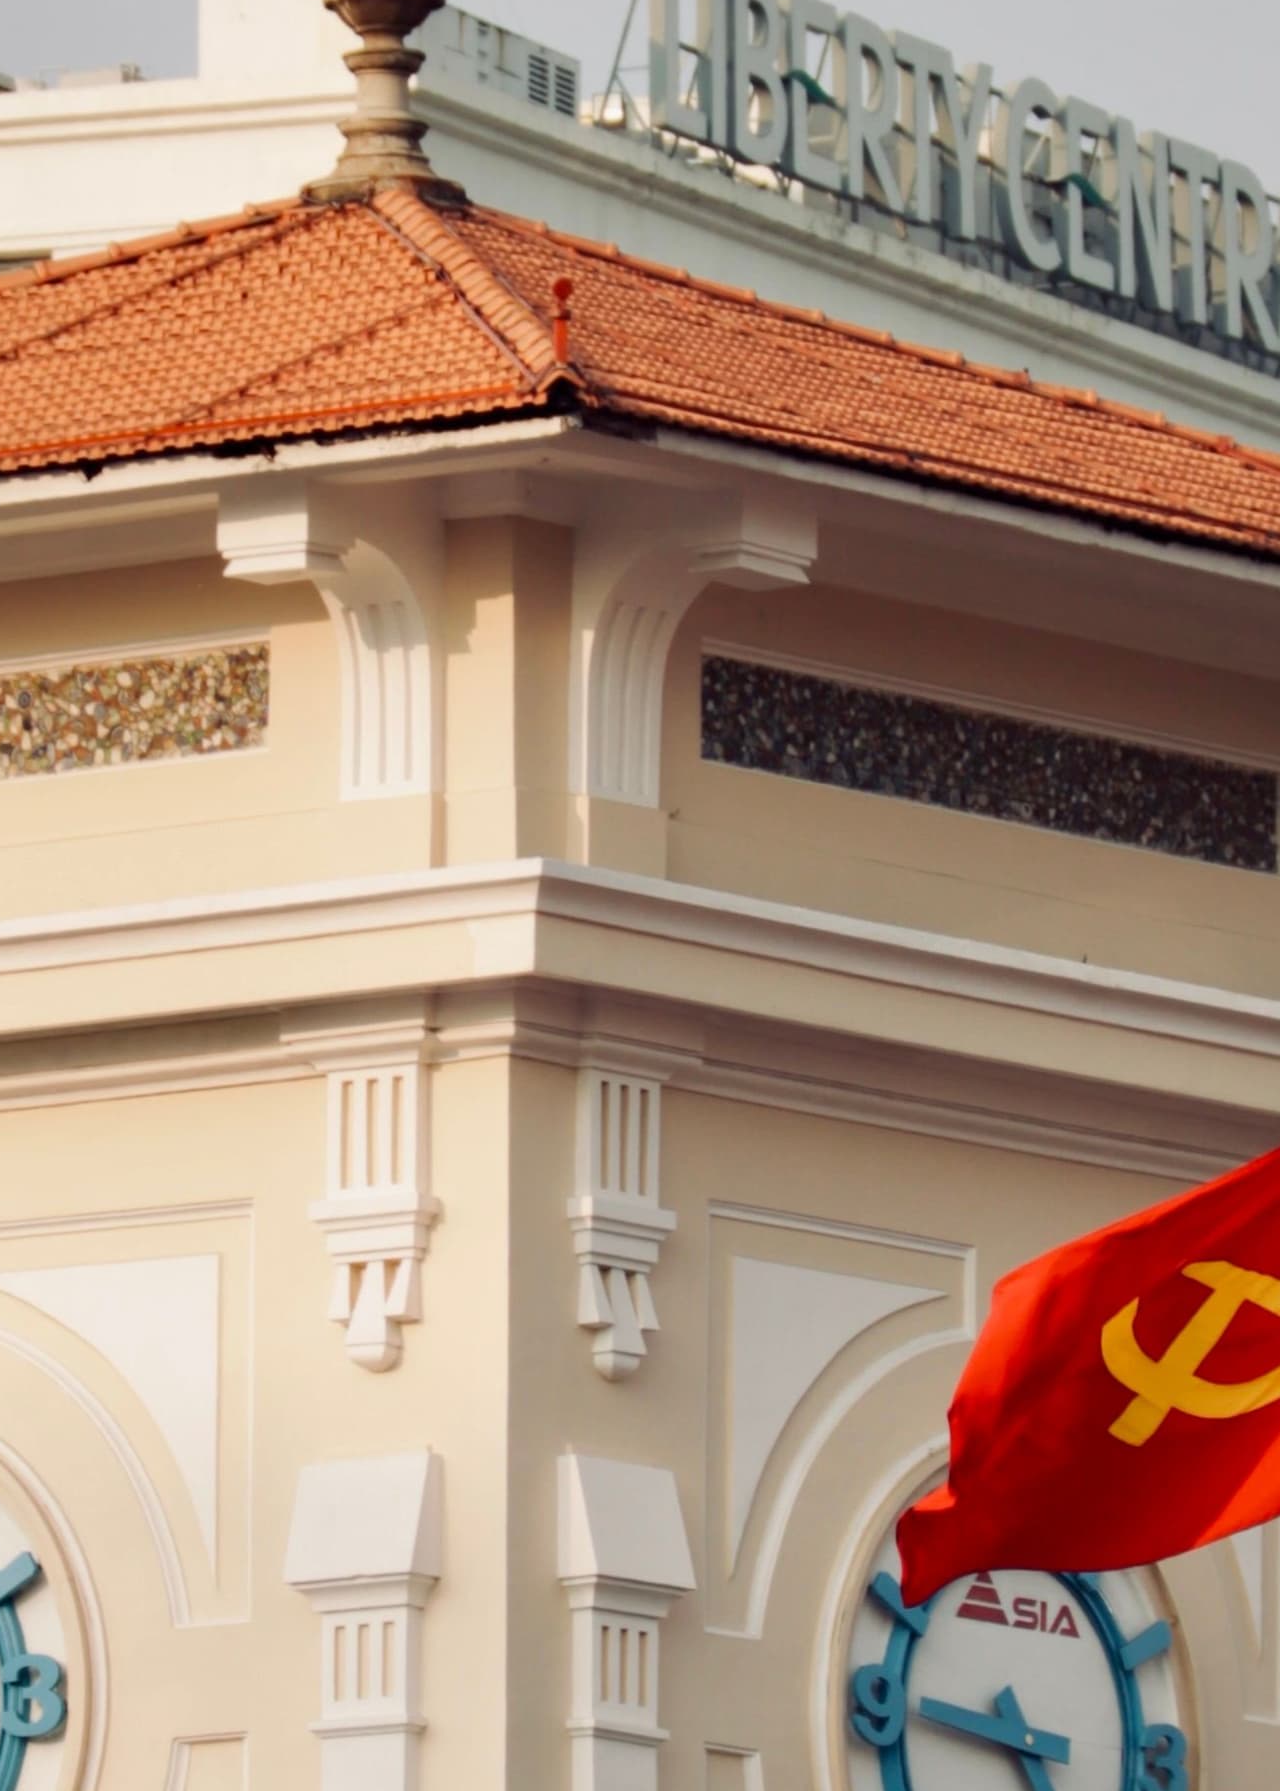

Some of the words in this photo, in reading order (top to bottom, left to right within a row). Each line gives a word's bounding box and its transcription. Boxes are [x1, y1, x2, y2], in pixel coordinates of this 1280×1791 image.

[955, 1571, 1080, 1639] ASIA
[1, 1654, 67, 1738] 3
[851, 1663, 908, 1748] 9
